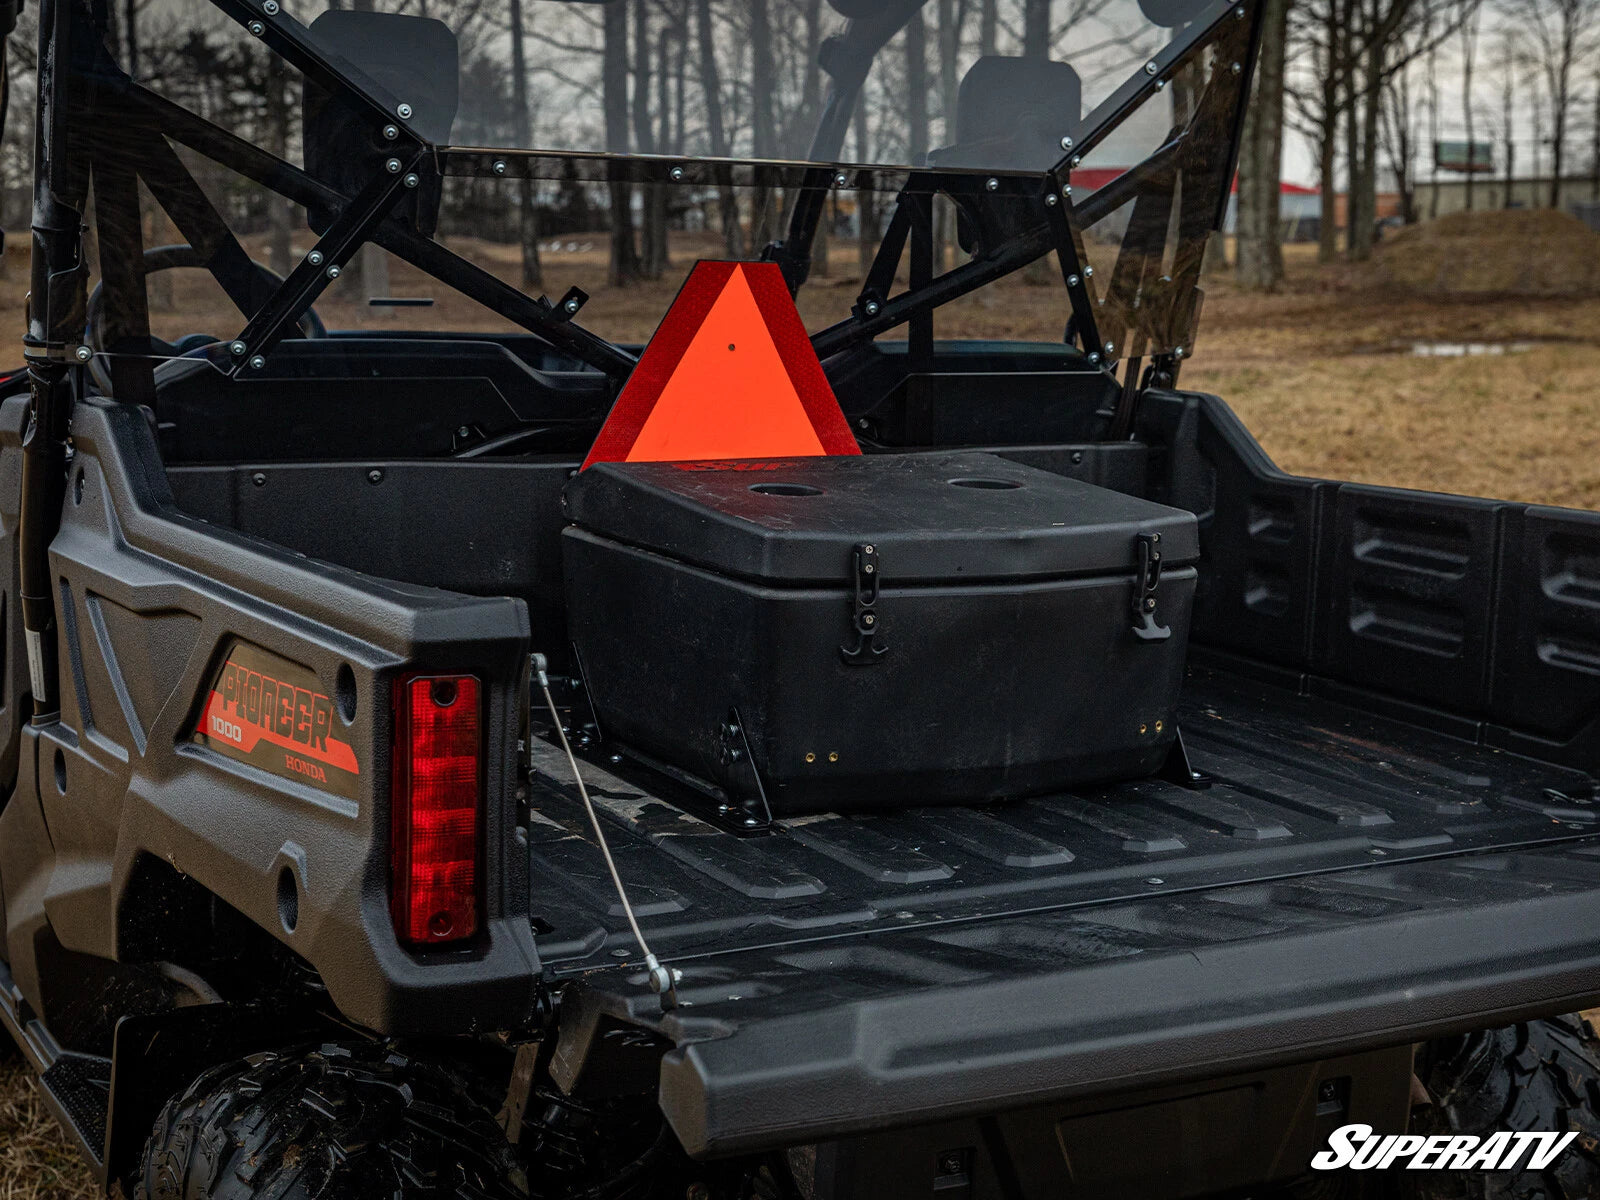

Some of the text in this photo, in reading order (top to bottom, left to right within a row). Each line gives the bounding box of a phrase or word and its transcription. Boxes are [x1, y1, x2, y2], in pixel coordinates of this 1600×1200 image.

[223, 662, 333, 753] PIONEER
[212, 716, 242, 743] 1000
[285, 755, 328, 783] HONDA
